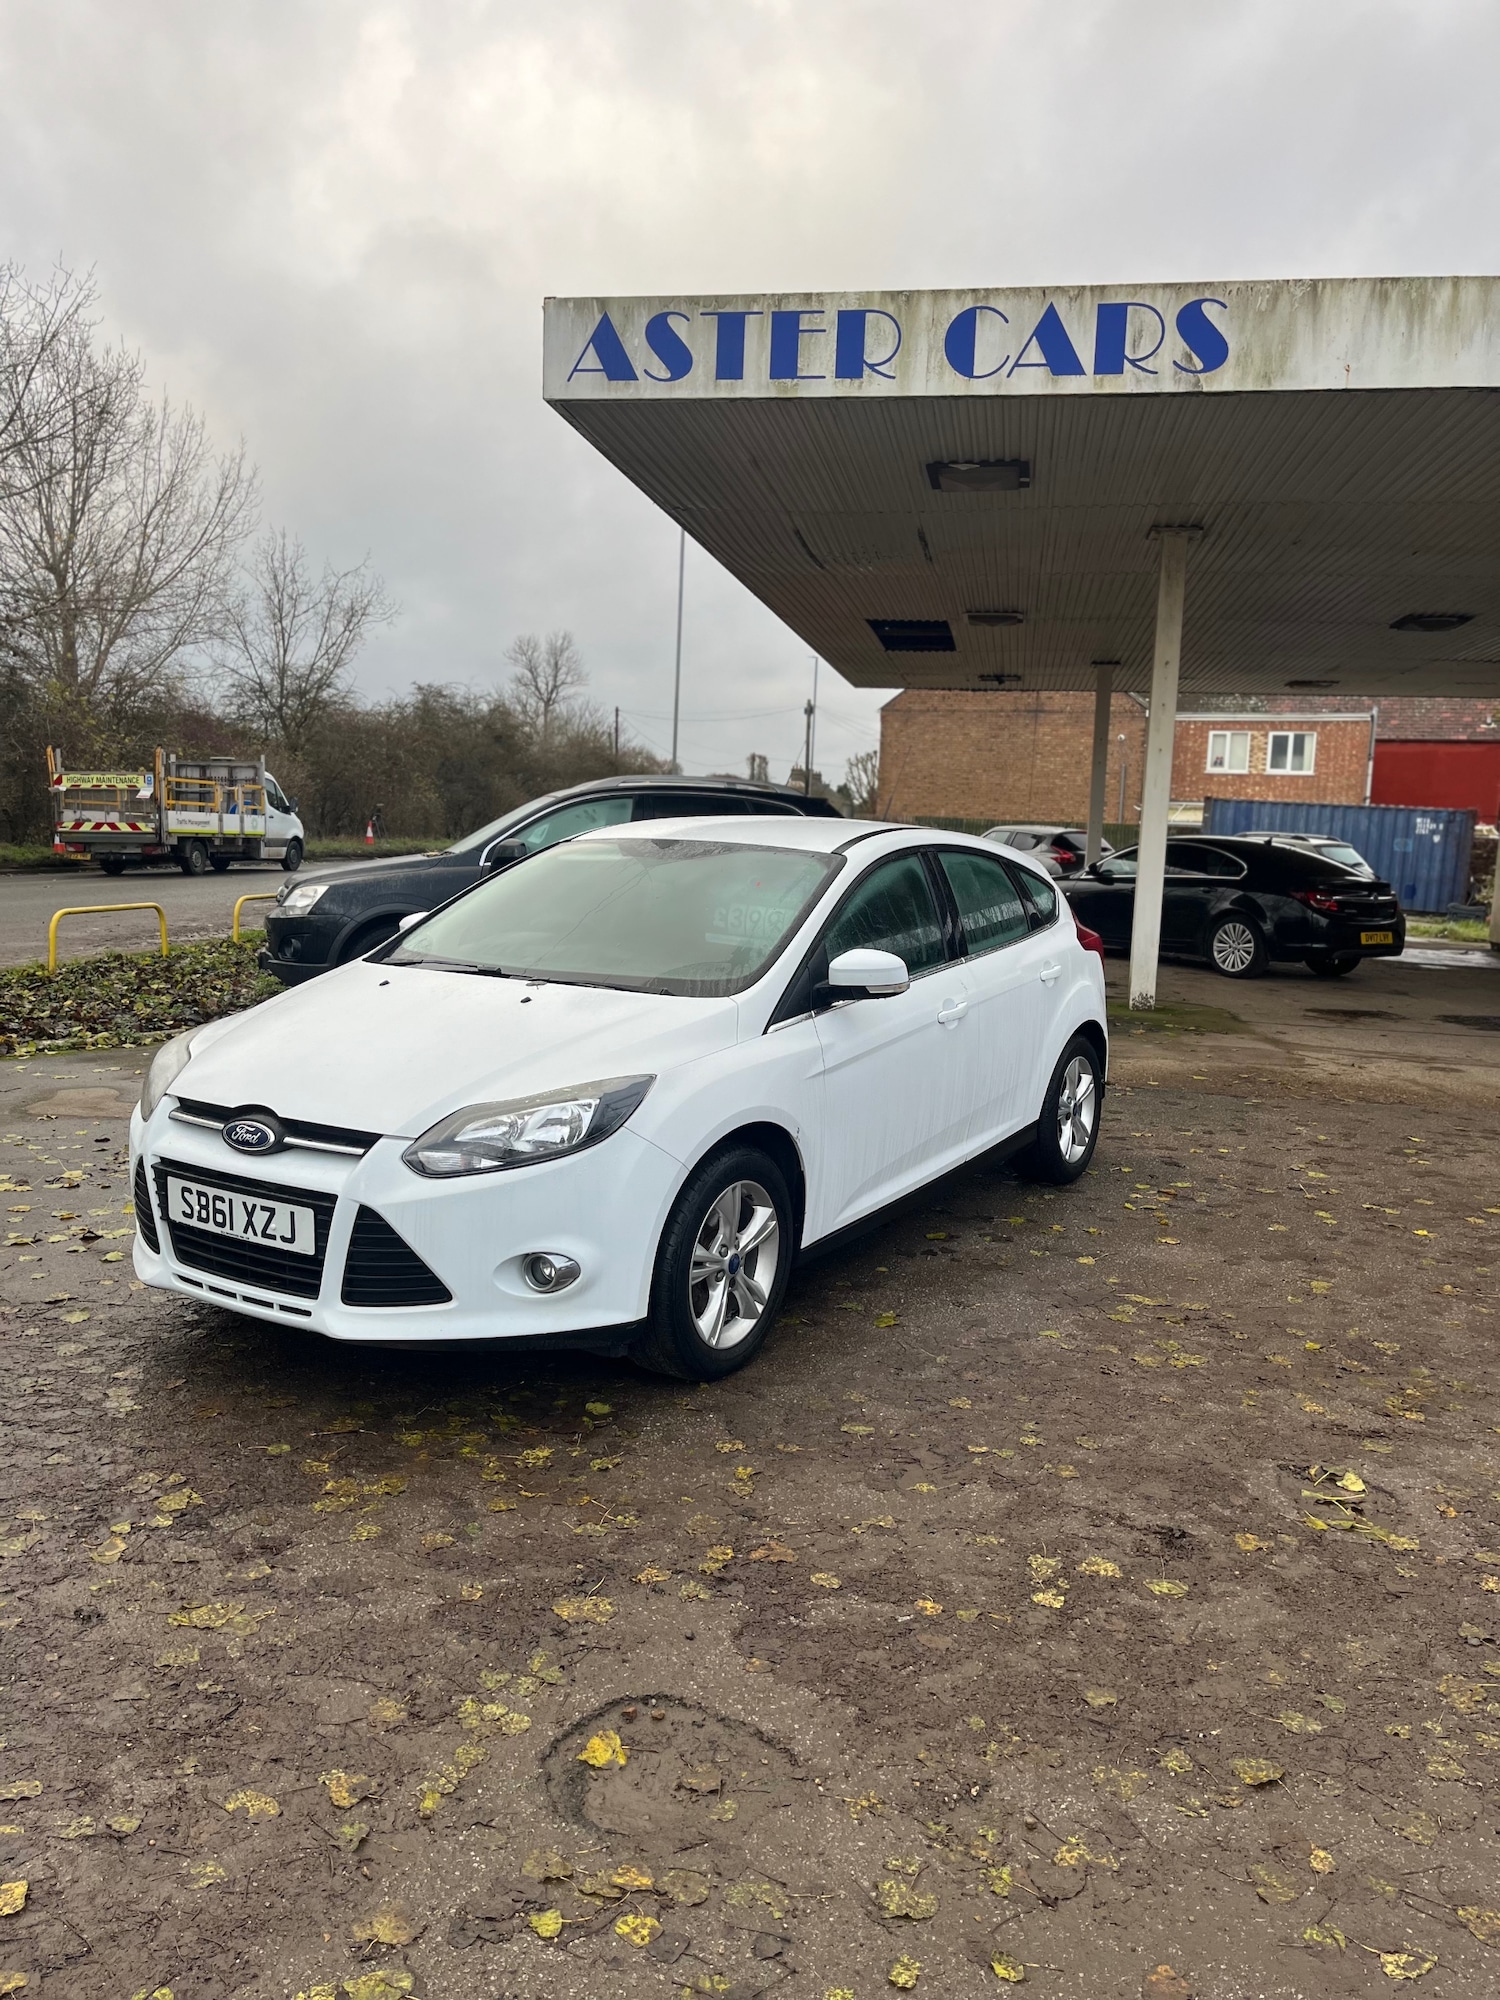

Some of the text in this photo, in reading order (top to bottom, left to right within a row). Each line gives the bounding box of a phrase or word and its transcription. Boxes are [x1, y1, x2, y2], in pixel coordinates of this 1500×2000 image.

[567, 298, 1229, 382] ASTER CARS
[66, 775, 95, 784] HIGHWAY
[96, 775, 140, 784] MAINTENANCE
[231, 1124, 261, 1144] Ford
[181, 1186, 296, 1244] SB61 XZJ
